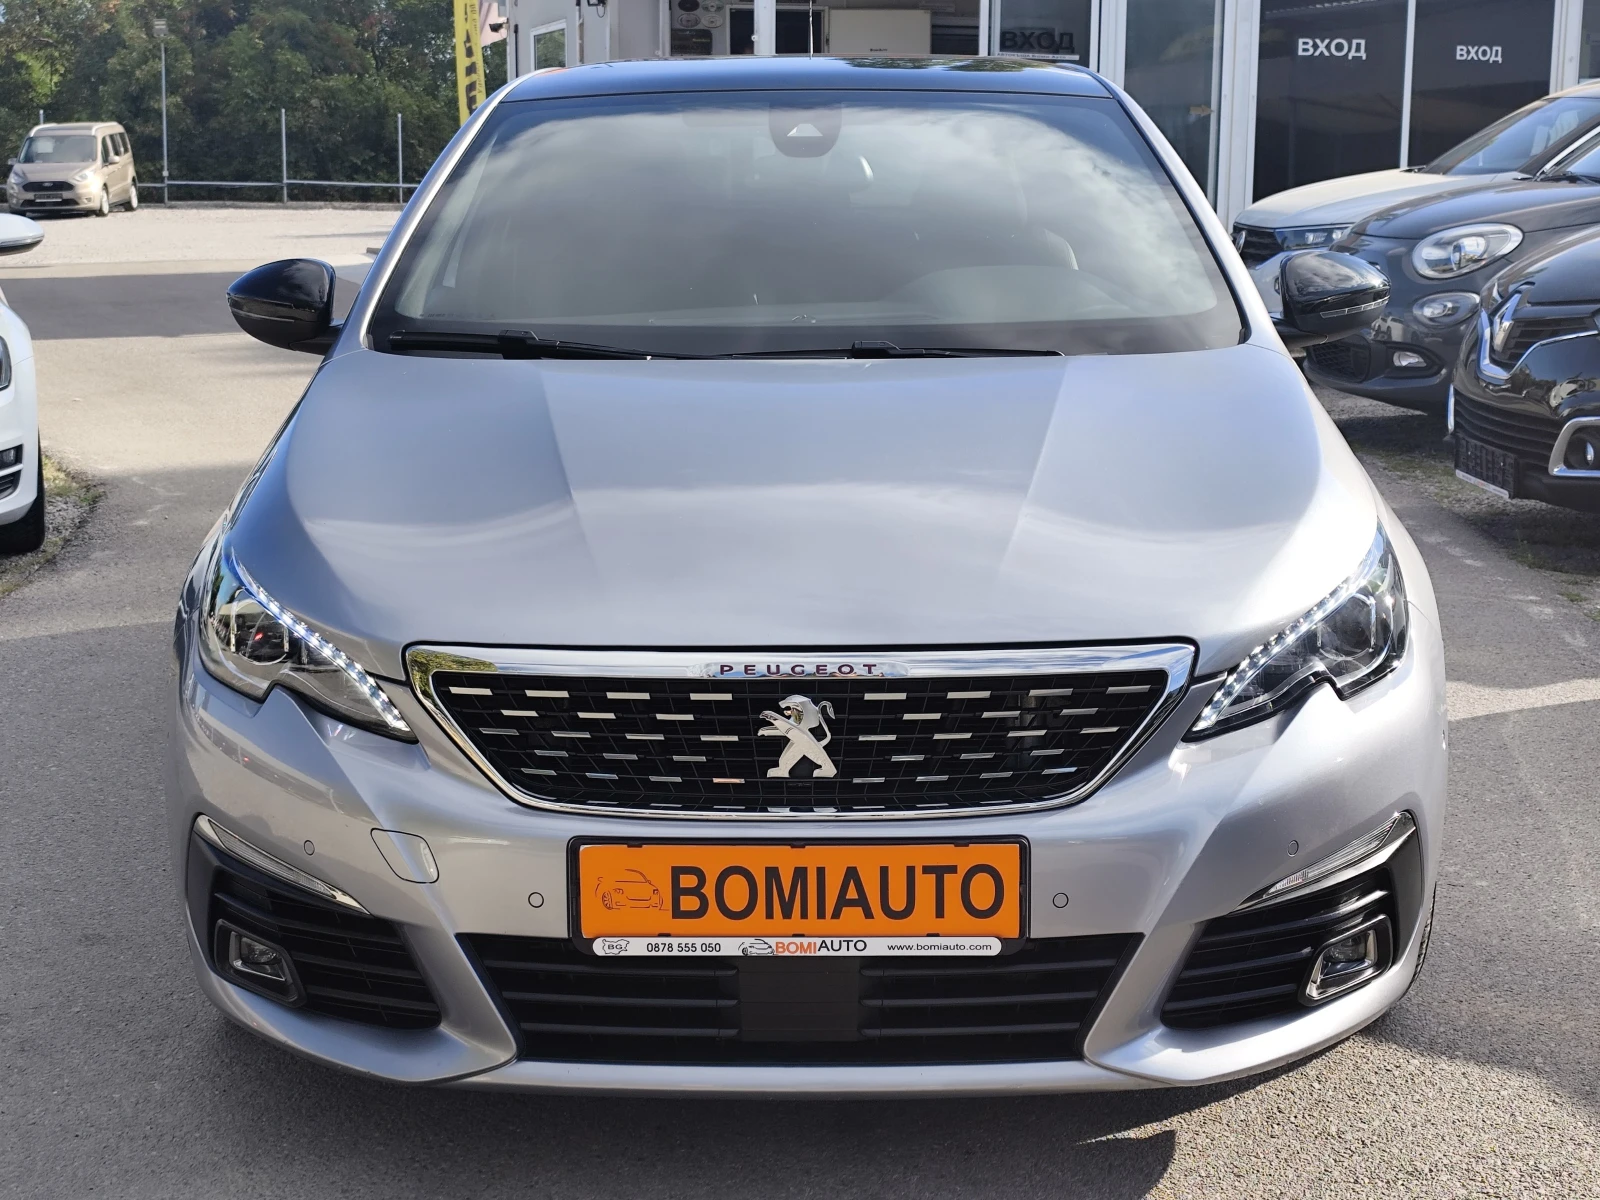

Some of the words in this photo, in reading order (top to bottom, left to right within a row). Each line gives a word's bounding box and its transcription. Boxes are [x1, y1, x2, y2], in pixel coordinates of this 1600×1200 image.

[1000, 31, 1075, 54] ВХОД
[1298, 38, 1367, 60] ВХОД
[1456, 45, 1502, 64] ВХОД
[719, 663, 878, 676] PEUGEOT
[670, 864, 1005, 921] BOMIAUTO
[646, 942, 674, 953] 0878
[677, 942, 697, 953] 555
[701, 942, 721, 953] 050
[887, 943, 992, 952] www.bomiauto.com
